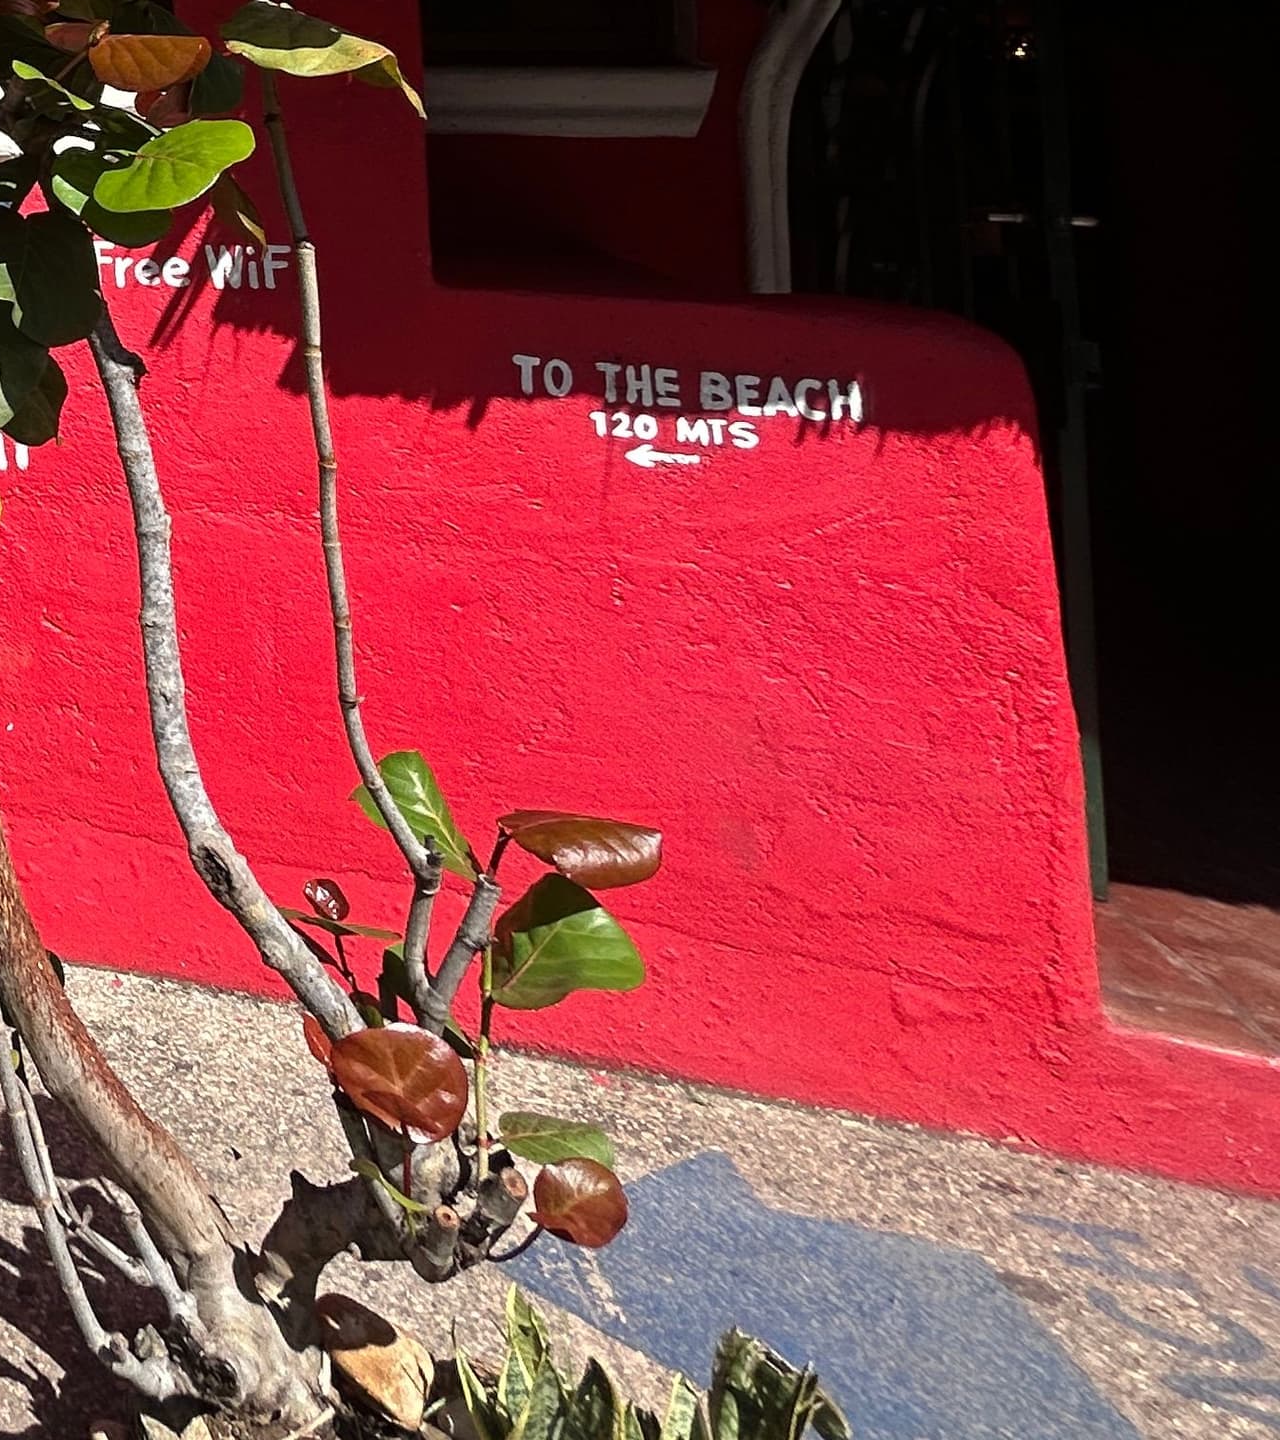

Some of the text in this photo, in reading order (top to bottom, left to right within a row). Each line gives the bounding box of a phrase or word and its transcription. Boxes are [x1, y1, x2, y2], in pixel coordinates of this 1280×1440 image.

[93, 240, 290, 289] Free WiF
[512, 355, 863, 422] TO THE BEACH
[589, 411, 759, 449] 120 MTS
